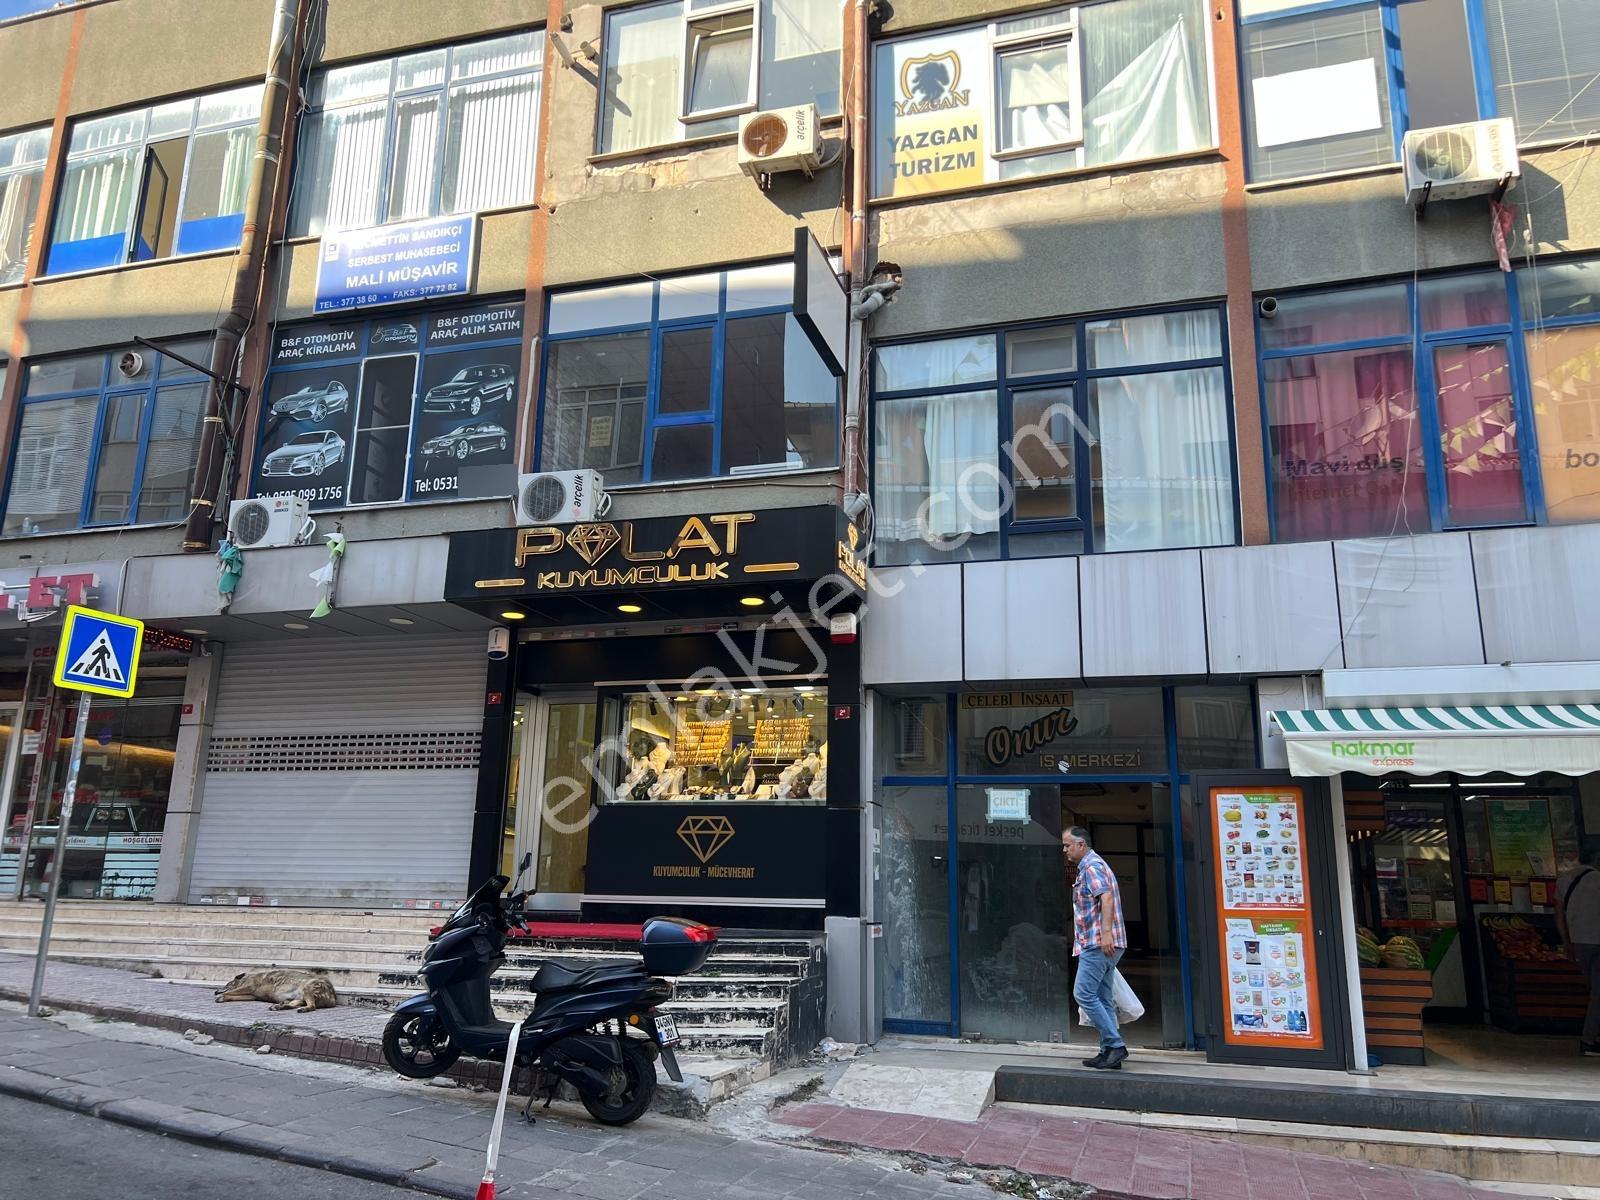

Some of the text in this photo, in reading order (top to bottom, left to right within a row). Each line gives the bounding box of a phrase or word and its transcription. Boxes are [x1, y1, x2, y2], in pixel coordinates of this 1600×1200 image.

[893, 89, 971, 117] YAZGAN
[796, 109, 806, 141] arçelik
[888, 123, 978, 153] YAZGAN
[889, 151, 976, 179] TURİZM
[411, 225, 463, 242] SANDIKÇI
[347, 241, 461, 268] SERBEST MUHASEBECİ
[346, 260, 459, 289] MALİ MÜŞAVİR
[340, 295, 356, 306] 377
[356, 295, 367, 305] 38
[367, 293, 378, 303] 60
[392, 288, 418, 299] FAKS:
[420, 285, 434, 295] 377
[437, 308, 517, 328] B&F OTOMOTİV
[281, 330, 355, 348] B&F OTOMOTİV
[430, 320, 521, 340] ARAÇ ALIM SATIM
[277, 341, 357, 359] ARAÇ KİRALAMA
[1285, 455, 1350, 478] Mavi
[318, 486, 343, 500] 1756
[415, 476, 459, 493] Tel: 0531
[573, 474, 584, 508] arçelik
[537, 560, 729, 590] KUYUMCULUK
[985, 707, 1079, 767] Onur
[1039, 748, 1142, 770] İŞ MERKEZİ
[1331, 741, 1416, 758] hakmar
[1372, 757, 1415, 767] express
[652, 865, 702, 879] KUYUMCULUK
[707, 864, 755, 879] MÜCEVHERAT
